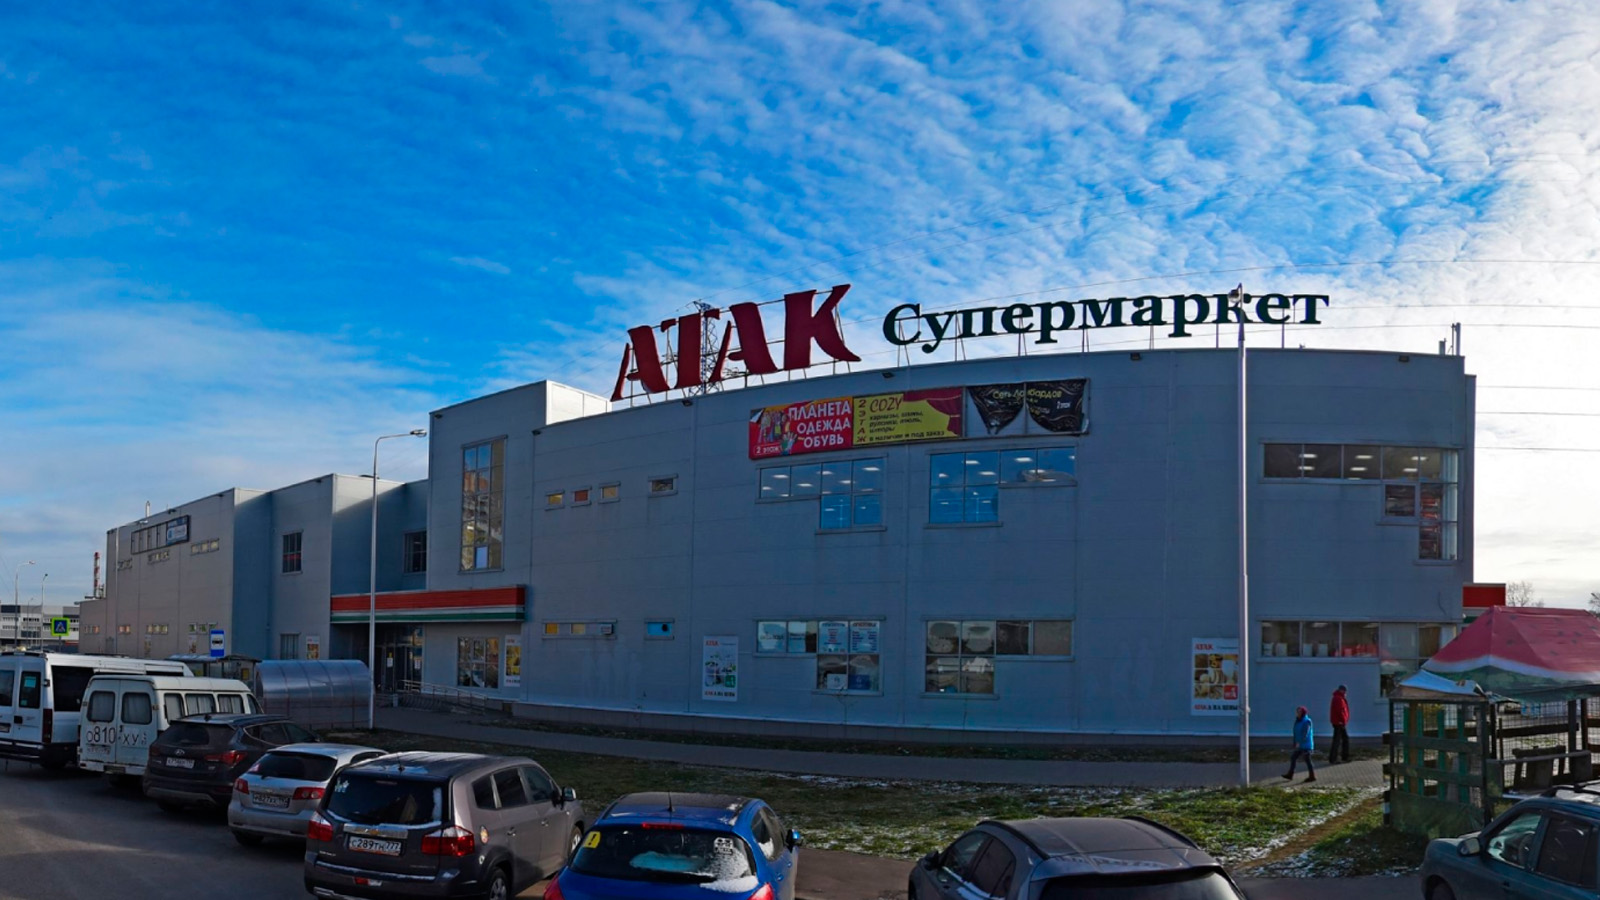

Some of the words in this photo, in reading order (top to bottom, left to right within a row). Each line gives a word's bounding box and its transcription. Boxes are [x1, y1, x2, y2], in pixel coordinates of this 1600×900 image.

[882, 293, 1329, 353] Супермаркет
[610, 283, 861, 402] АТАК
[788, 400, 852, 420] ПЛАНЕТА
[858, 399, 867, 408] 2
[869, 396, 903, 413] COZY
[797, 417, 851, 435] ОДЕЖДА
[857, 410, 867, 443] ЭТАЖ
[803, 433, 844, 448] ОБУВЬ
